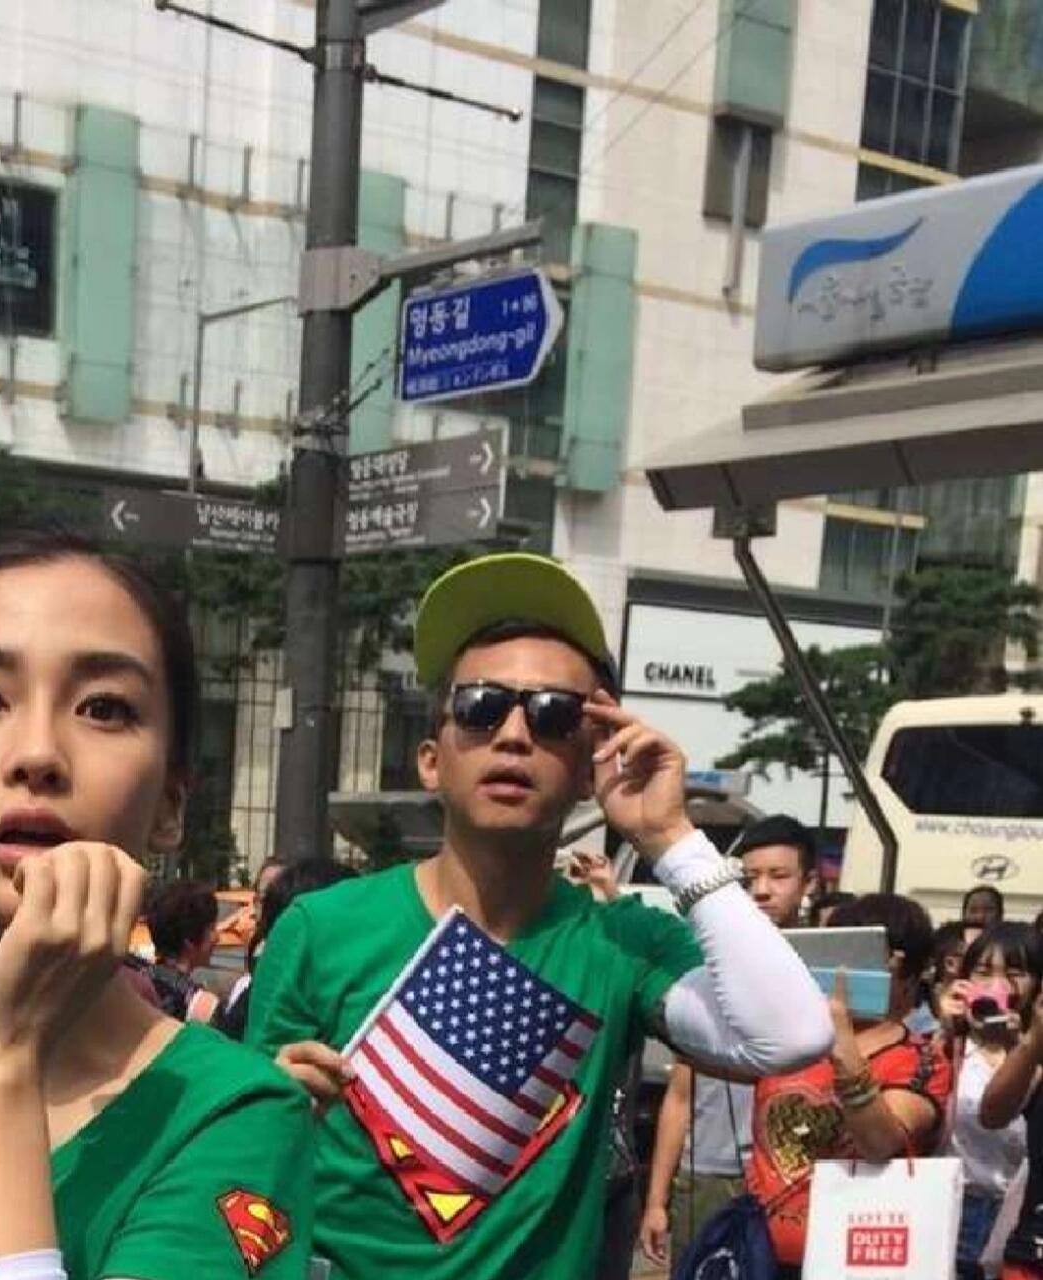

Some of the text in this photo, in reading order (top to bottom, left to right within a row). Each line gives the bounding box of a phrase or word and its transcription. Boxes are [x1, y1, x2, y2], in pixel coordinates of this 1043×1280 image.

[410, 321, 537, 367] Myeongdong-gil
[644, 661, 716, 689] CHANEL
[851, 1230, 906, 1246] DUTY
[851, 1245, 905, 1262] FREE
